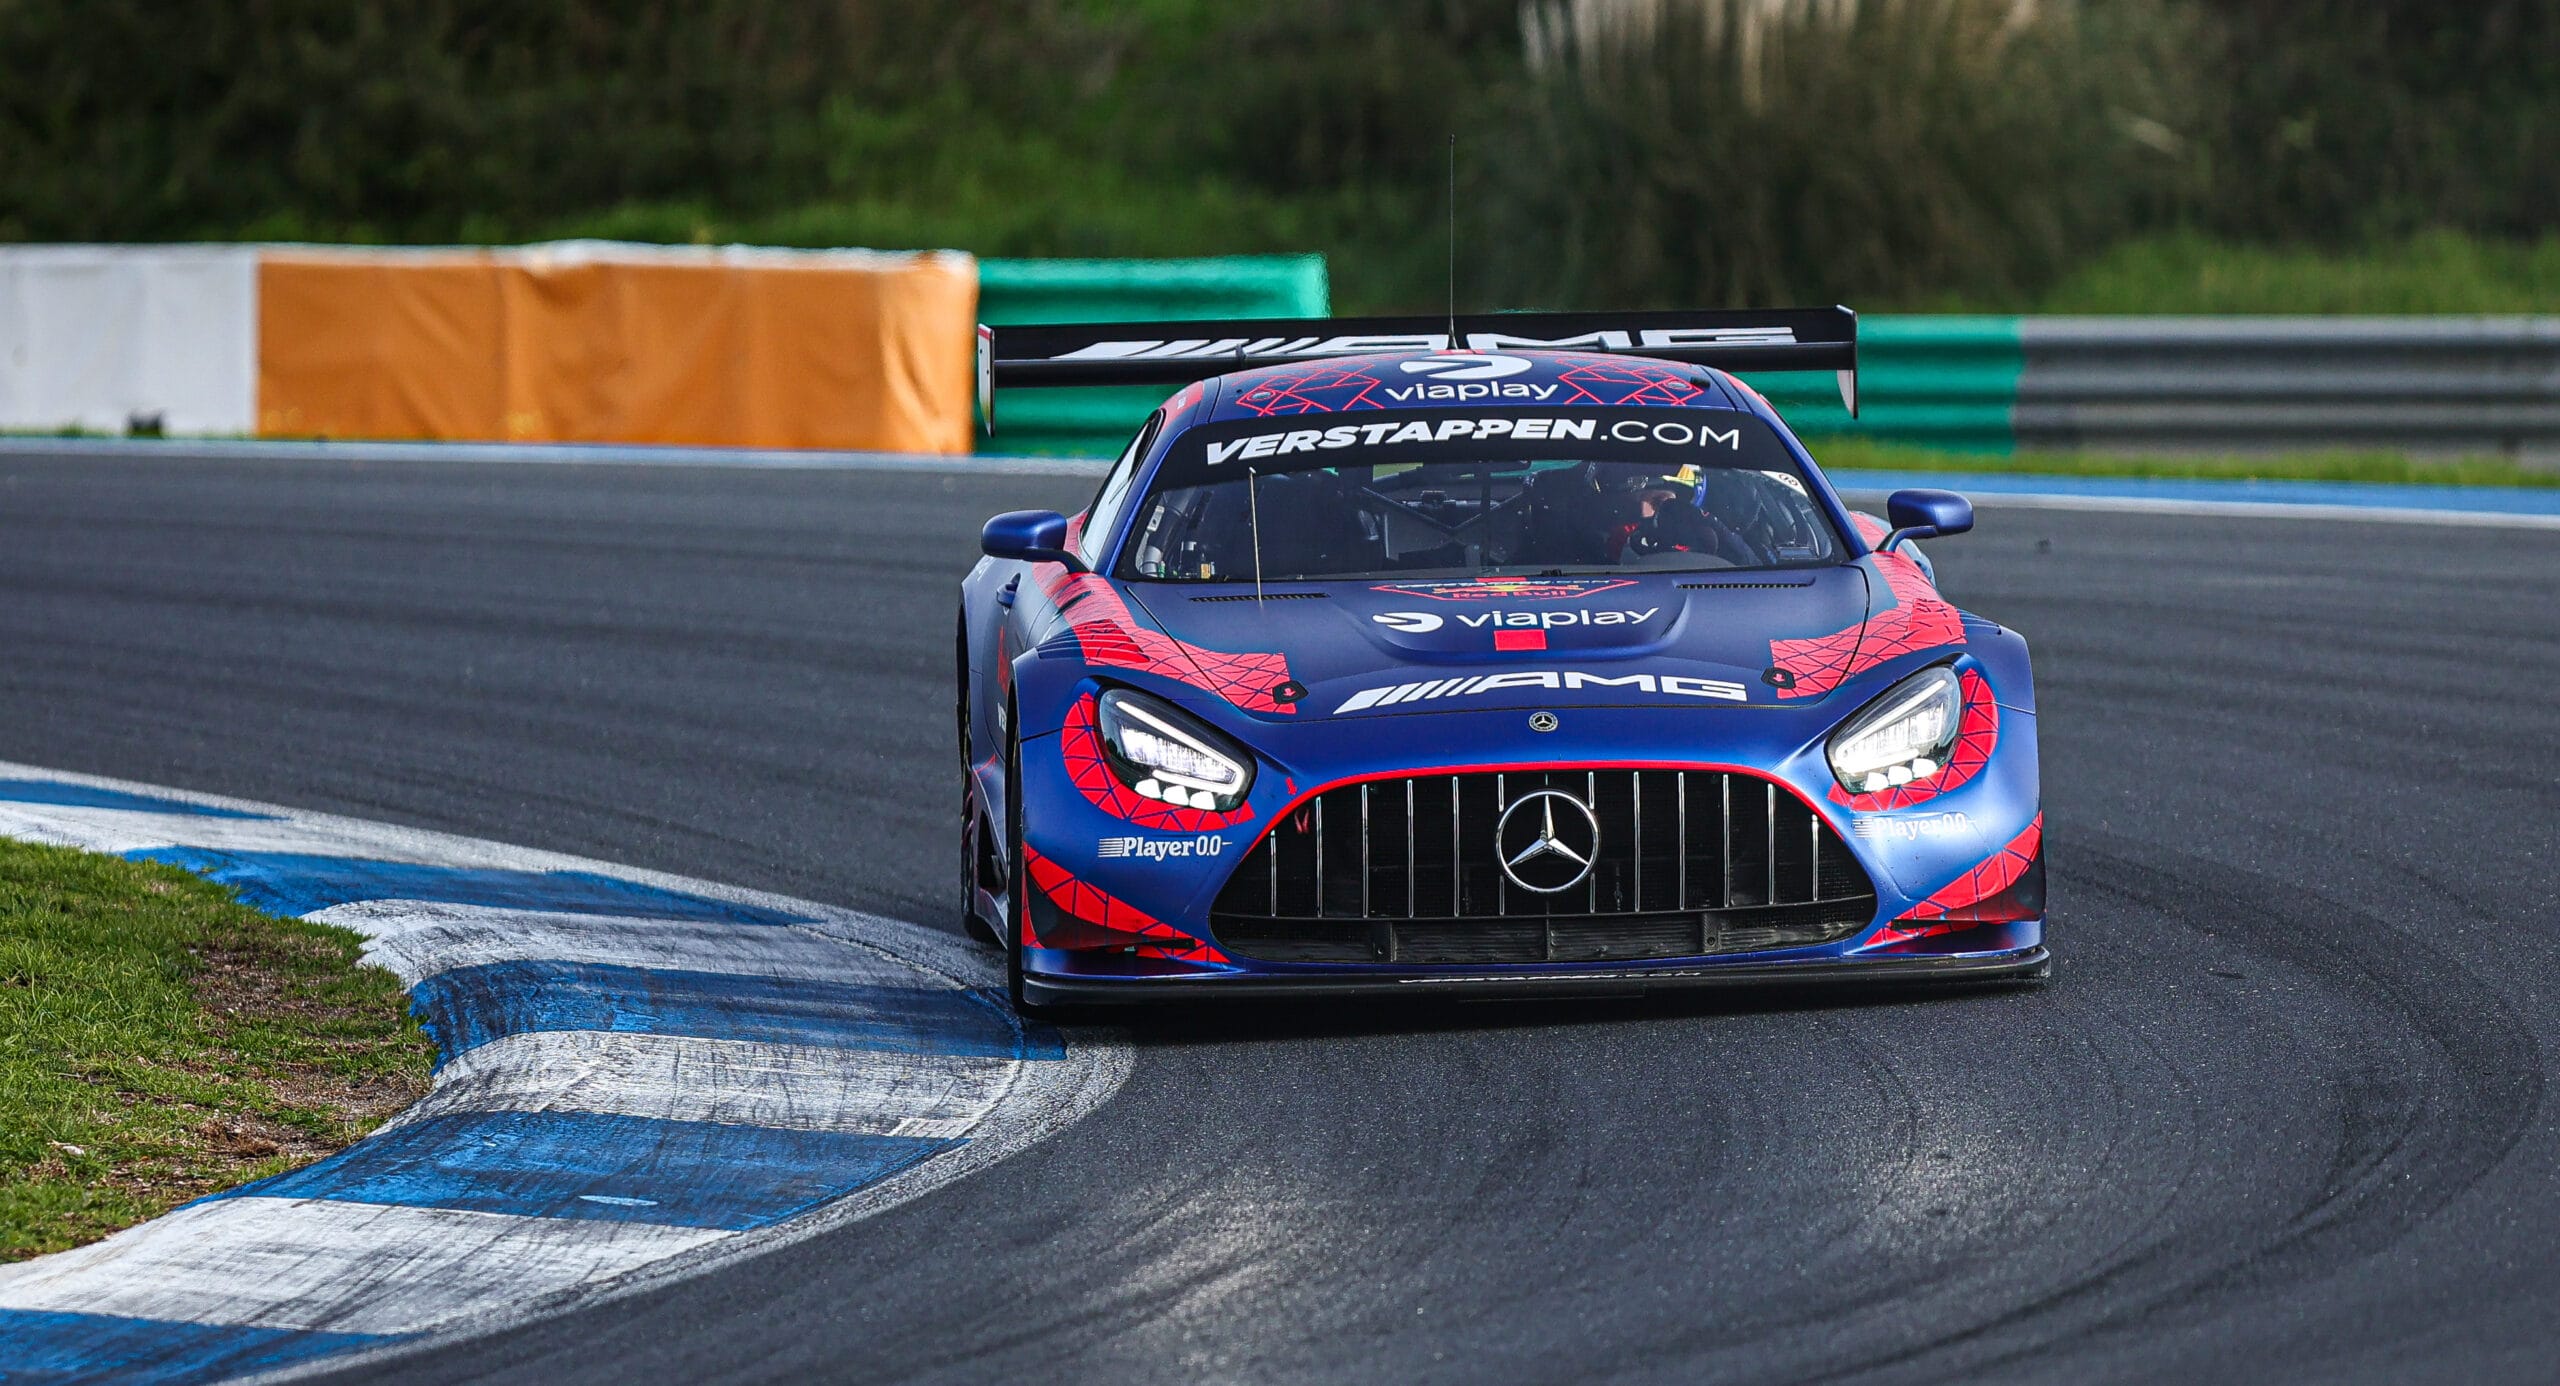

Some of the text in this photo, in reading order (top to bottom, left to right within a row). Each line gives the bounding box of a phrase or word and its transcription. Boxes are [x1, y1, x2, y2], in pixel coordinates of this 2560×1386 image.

[1289, 327, 1798, 356] AMG
[1384, 380, 1559, 401] viaplay
[1206, 418, 1740, 467] VERSTAPPEN.COM
[1455, 607, 1660, 630] viaplay
[1464, 671, 1748, 702] AMG
